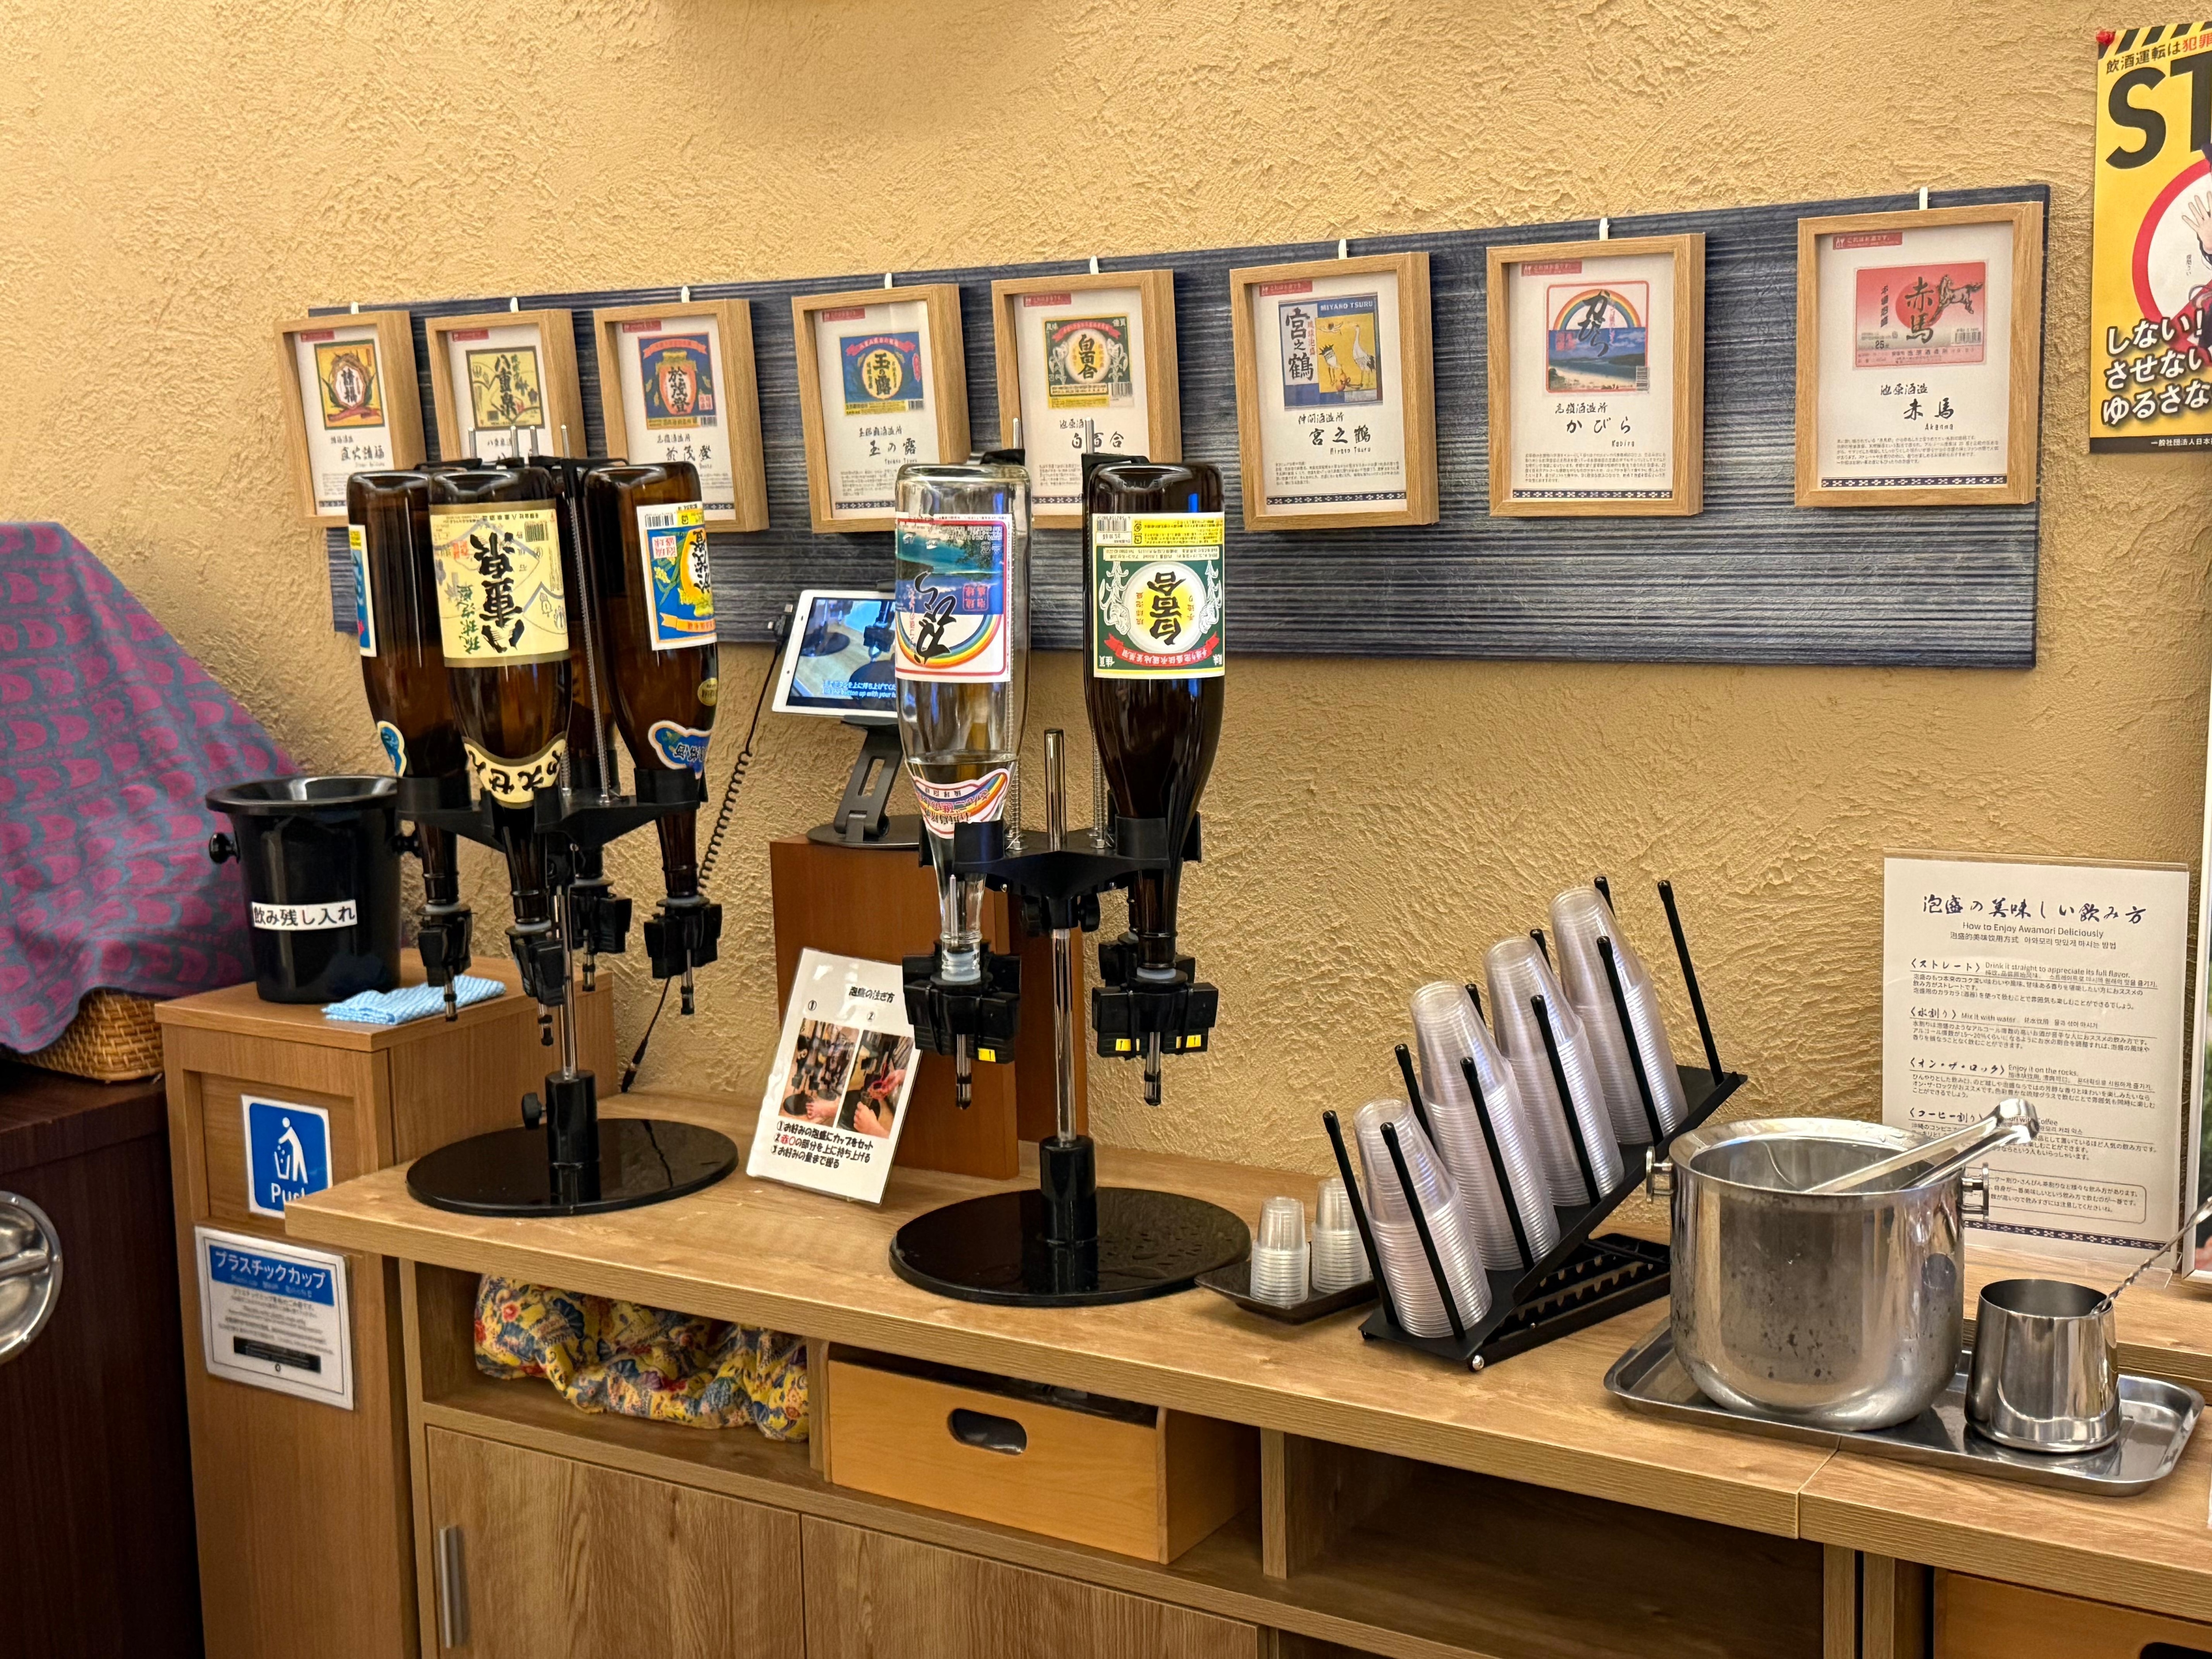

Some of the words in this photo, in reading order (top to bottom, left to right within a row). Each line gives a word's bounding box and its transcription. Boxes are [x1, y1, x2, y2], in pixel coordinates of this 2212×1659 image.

[1905, 276, 1935, 344] 赤馬
[1285, 307, 1313, 381] 宮之鶴
[1077, 334, 1098, 380] 白百合
[873, 352, 892, 396] 玉の露
[494, 354, 518, 418] 八重泉
[1880, 383, 1928, 396] 池原酒造
[1903, 397, 1955, 421] 赤馬
[2102, 379, 2212, 426] ゆるさな
[1060, 419, 1084, 429] 池原酒
[1566, 416, 1632, 434] かびら
[1309, 424, 1371, 446] 宮之鶴
[869, 438, 917, 457] 玉の露
[470, 532, 525, 654] 八重泉
[1146, 571, 1187, 646] 白百合
[253, 906, 355, 926] 飲み残し入れ
[1923, 894, 2147, 925] 泡盛の美味しい飲み方
[1993, 924, 2016, 933] Enjoy
[2018, 926, 2056, 935] Awamori
[2058, 928, 2104, 939] Deliciously
[2078, 940, 2100, 949] 마시는
[2011, 964, 2037, 973] straight
[2047, 968, 2085, 976] appreciate
[848, 986, 895, 1004] 泡盛の注ぎ方
[1910, 1006, 1956, 1020] 〈水割り〉
[2008, 1064, 2027, 1073] Enjoy
[1991, 1176, 2138, 1197] ーサー割り・さんぴん茶割りなど様々な飲み方があります。
[215, 1250, 326, 1289] プラスチックカップ
